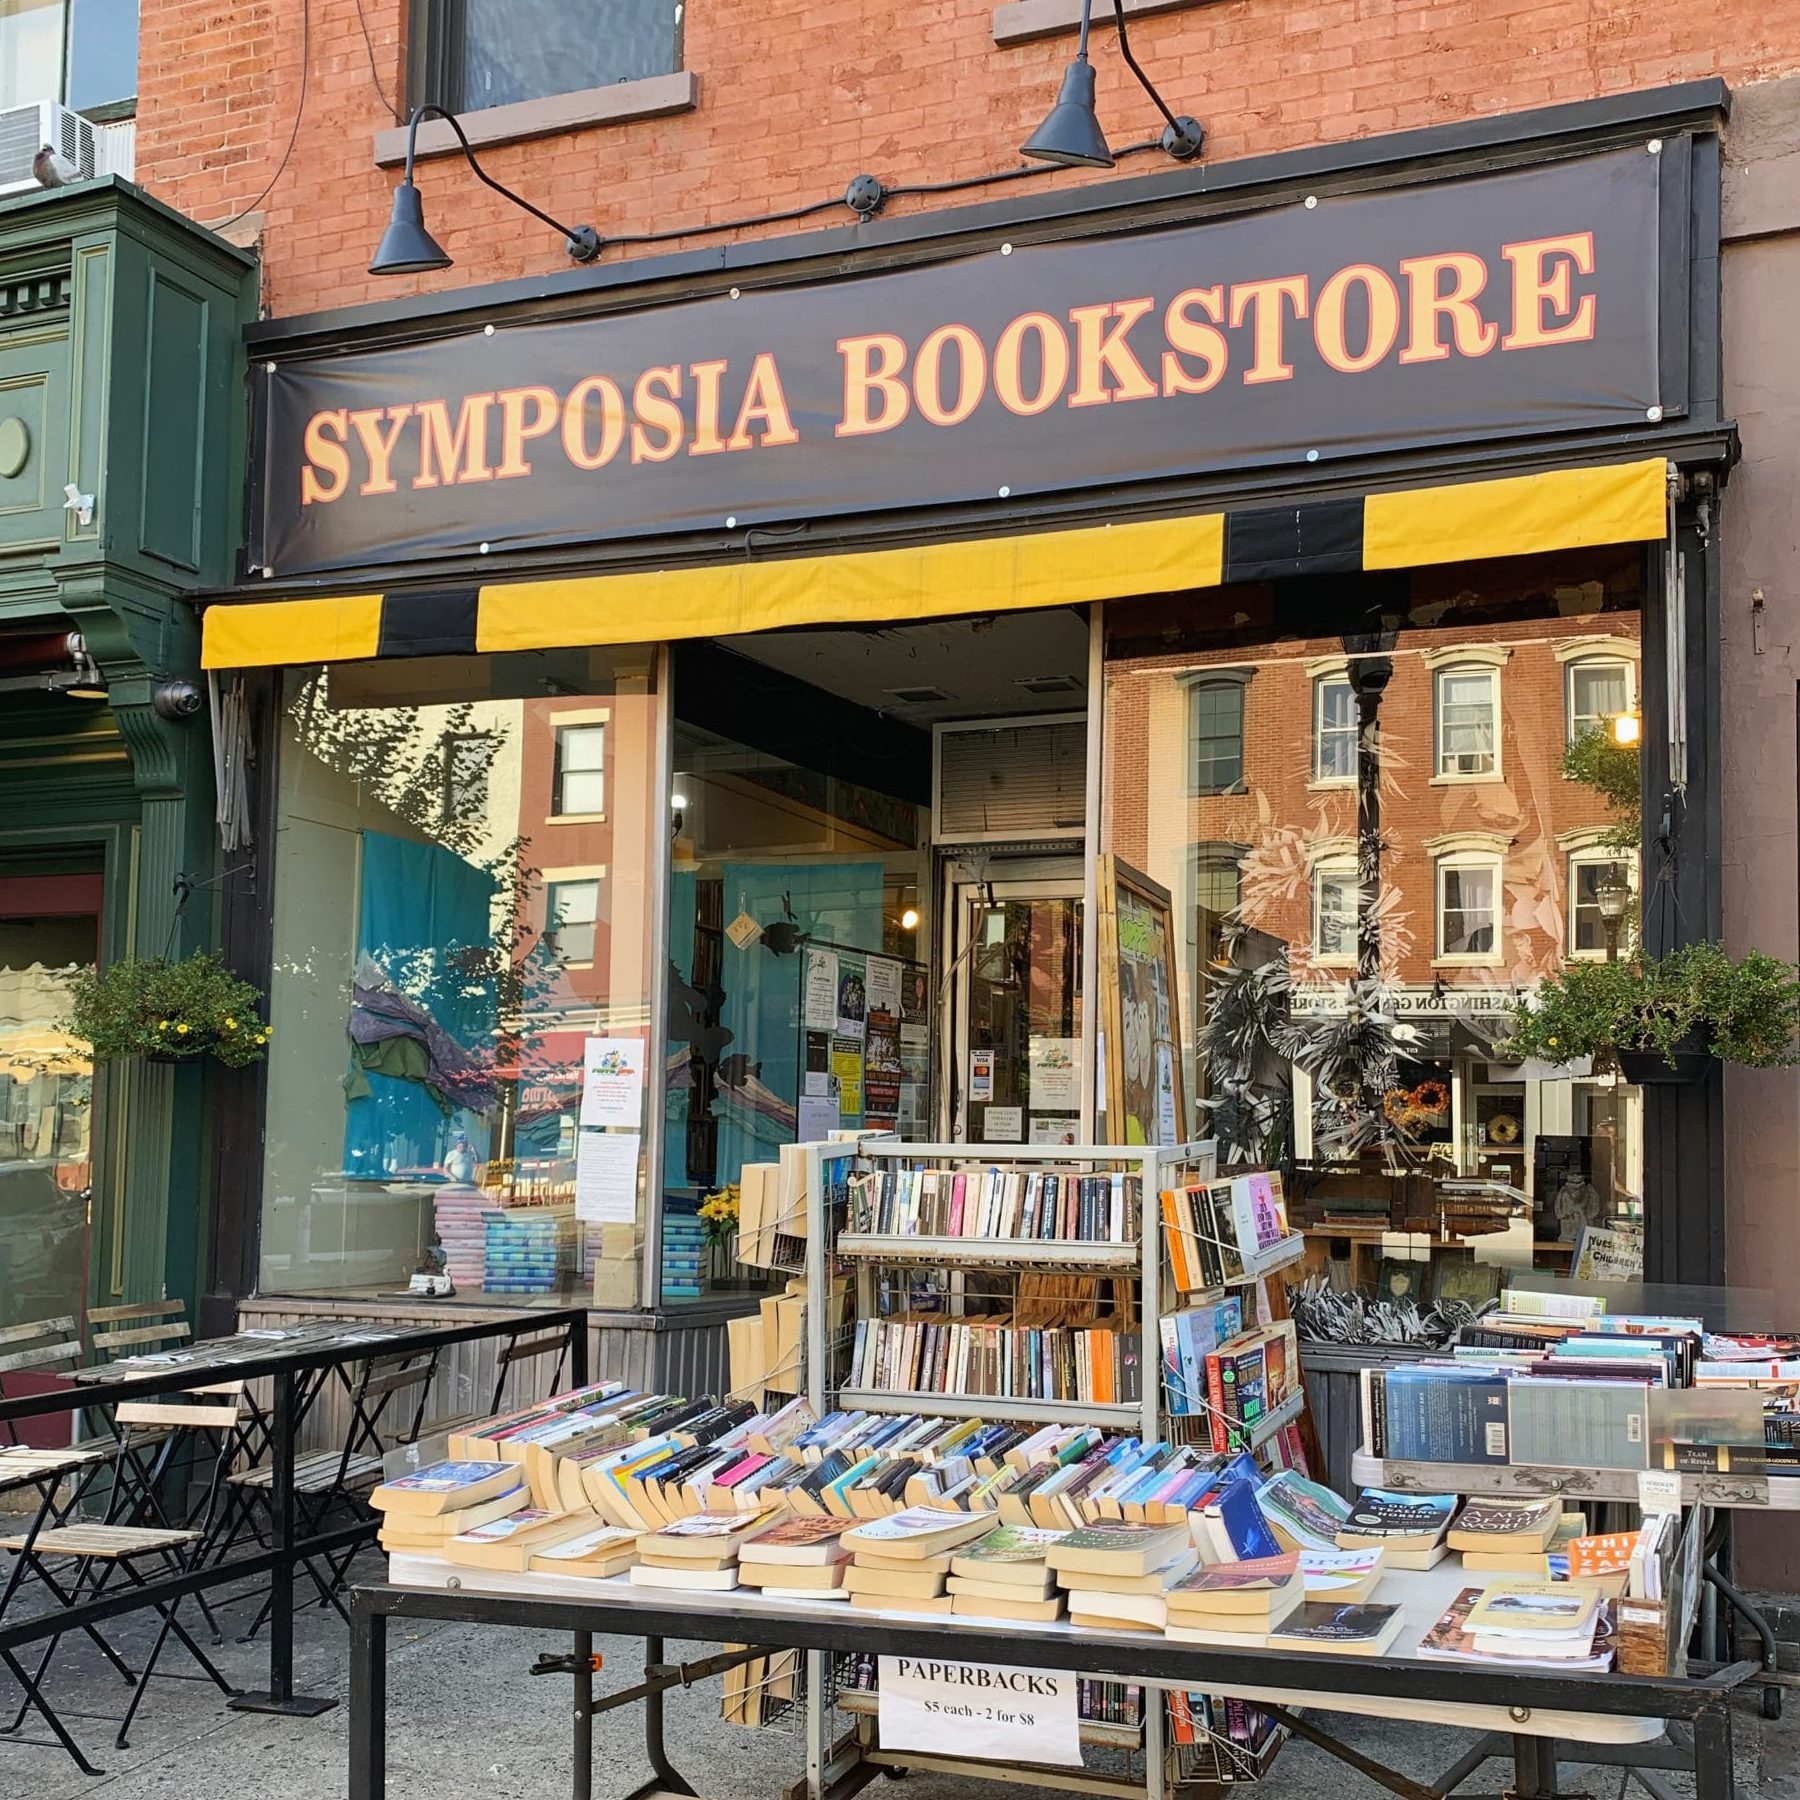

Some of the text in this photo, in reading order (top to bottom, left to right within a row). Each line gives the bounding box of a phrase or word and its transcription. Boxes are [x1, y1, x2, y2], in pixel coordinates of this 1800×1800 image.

[301, 231, 1596, 505] SYMPOSIA BOOKSTORE
[1208, 1367, 1219, 1386] LINDA
[1687, 1450, 1708, 1458] TEAM
[1690, 1458, 1716, 1466] RIVALS
[1369, 1505, 1438, 1515] STEALING
[1377, 1511, 1431, 1519] HORSES
[1462, 1516, 1490, 1524] OF
[1576, 1536, 1640, 1549] WHI
[897, 1658, 1059, 1697] PAPERBACKS
[924, 1700, 940, 1714] $5
[943, 1703, 973, 1718] each
[985, 1707, 993, 1720] 2
[997, 1708, 1016, 1724] for
[1019, 1712, 1035, 1727] $8
